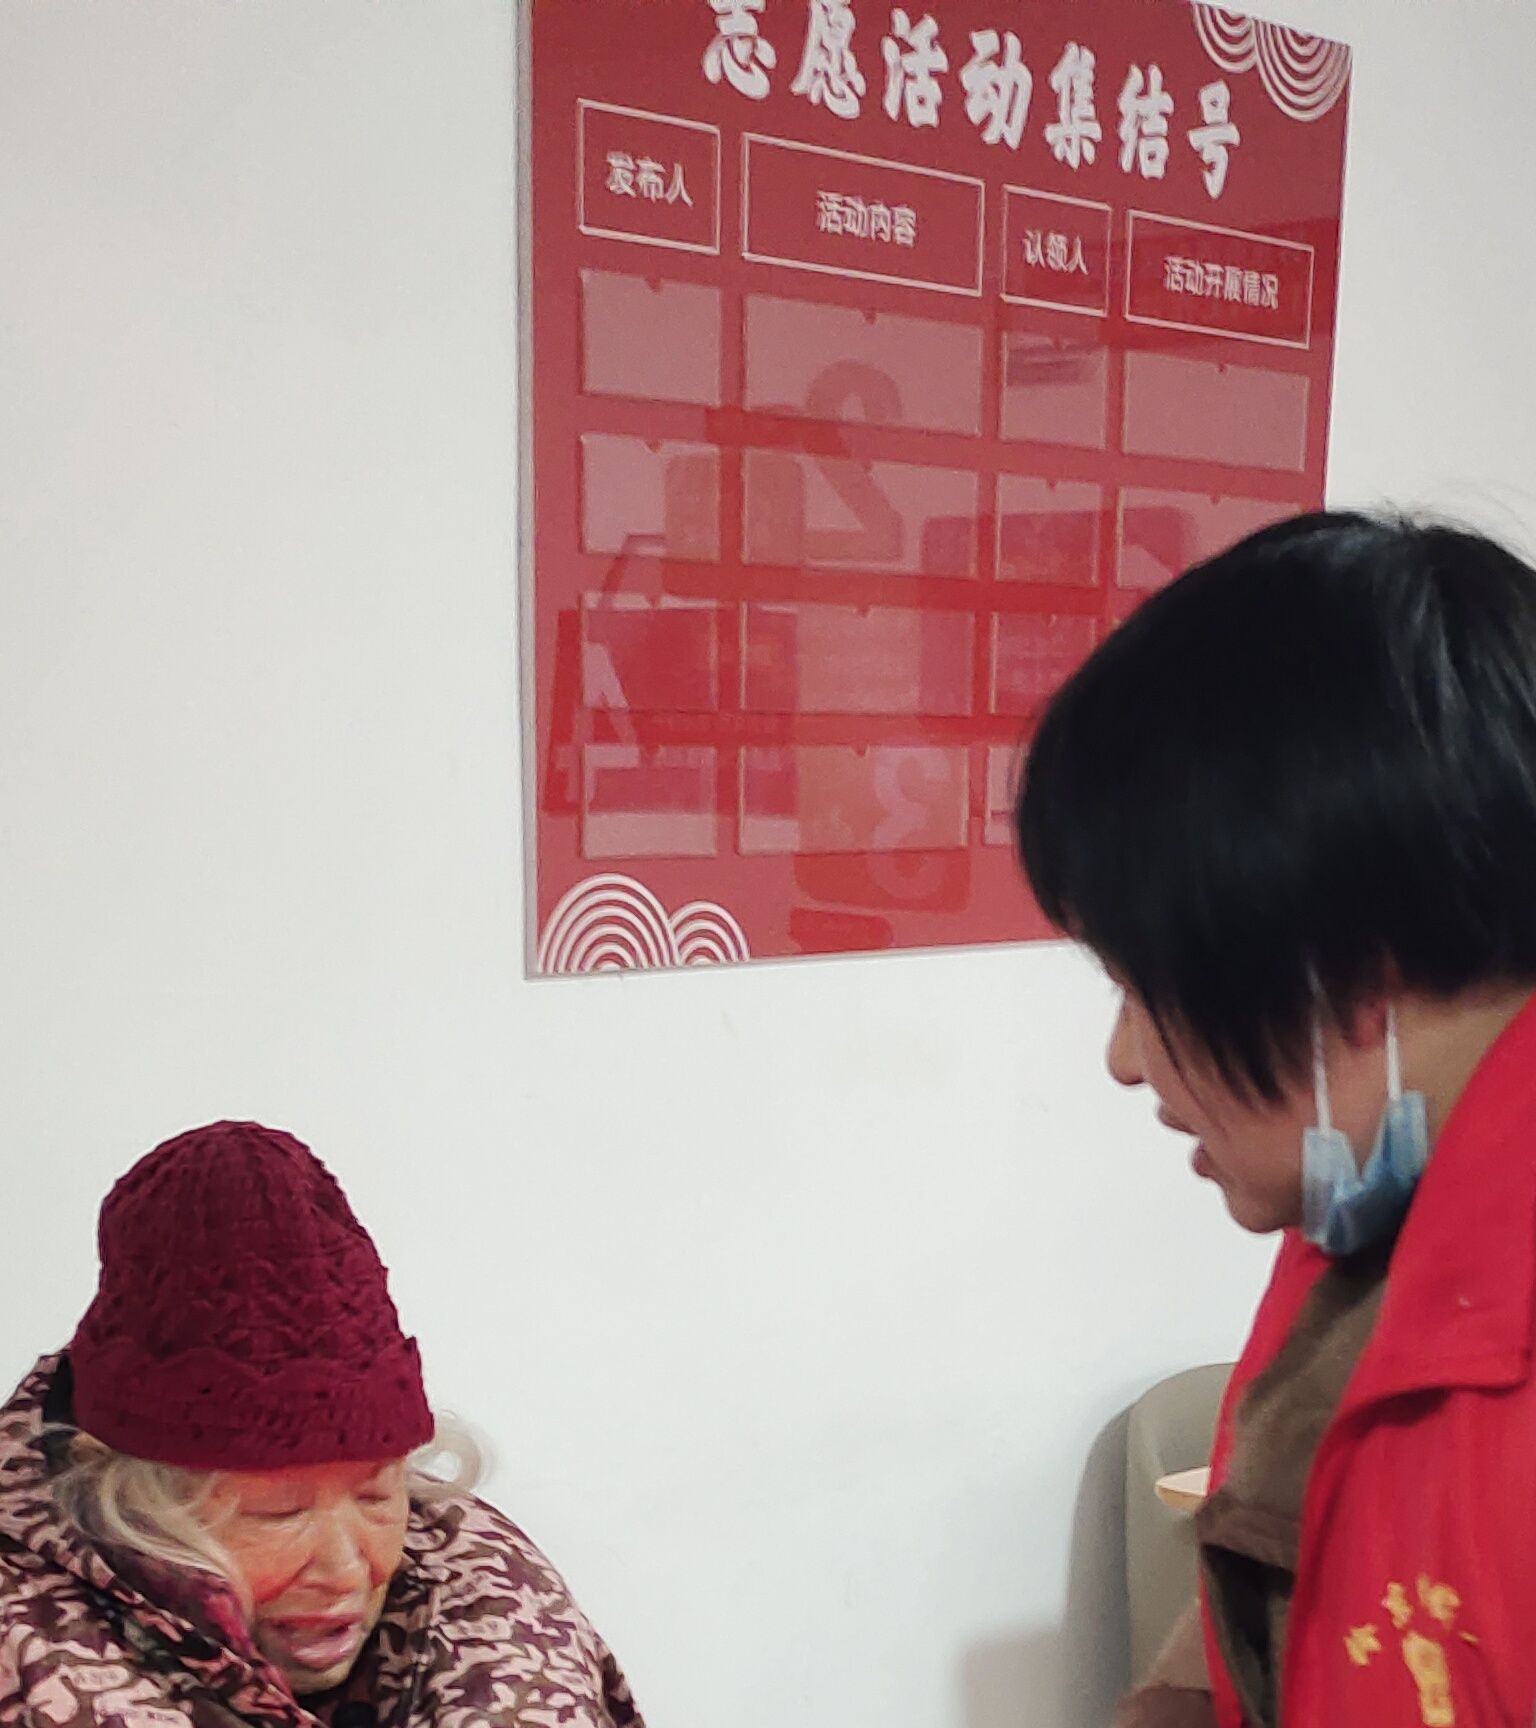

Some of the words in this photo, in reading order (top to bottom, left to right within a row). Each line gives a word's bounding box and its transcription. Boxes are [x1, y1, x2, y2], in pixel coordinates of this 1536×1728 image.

[702, 0, 1242, 198] 志愿活动集结号
[606, 151, 693, 207] 发布人
[817, 190, 916, 248] 活动内容
[1023, 230, 1088, 275] 认领人
[1165, 256, 1279, 310] 活动开展情况
